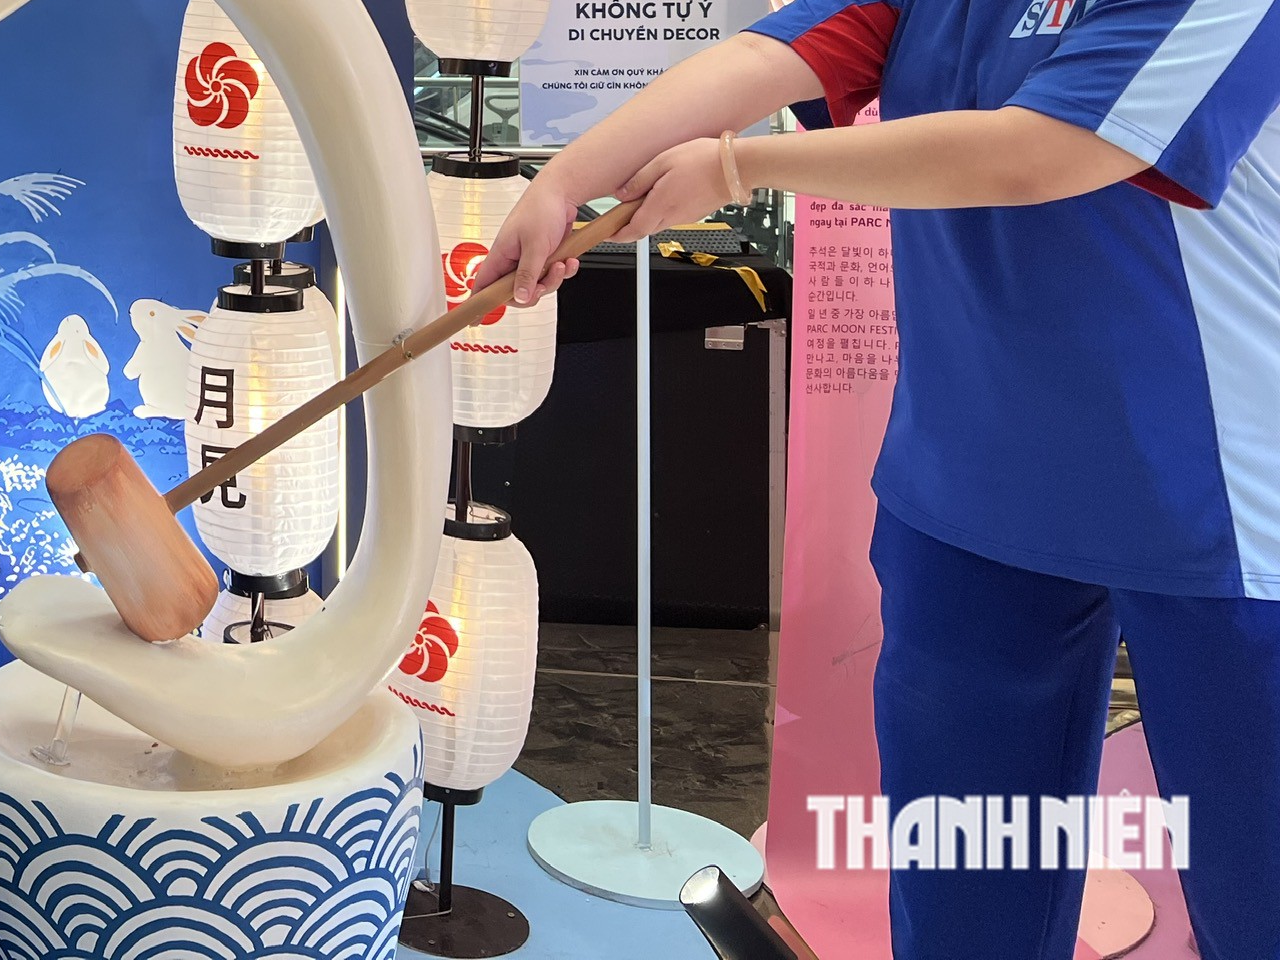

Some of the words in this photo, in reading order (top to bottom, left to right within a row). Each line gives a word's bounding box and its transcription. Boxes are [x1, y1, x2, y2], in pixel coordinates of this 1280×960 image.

[662, 0, 694, 22] TỰ
[568, 29, 585, 41] DI
[589, 25, 658, 41] CHUYỂN
[663, 28, 720, 40] DECOR
[542, 81, 572, 89] CHÚNG
[809, 218, 832, 229] ngay
[834, 217, 848, 228] tại
[850, 217, 883, 228] PARC
[806, 324, 829, 334] PARC
[831, 324, 866, 334] MOON
